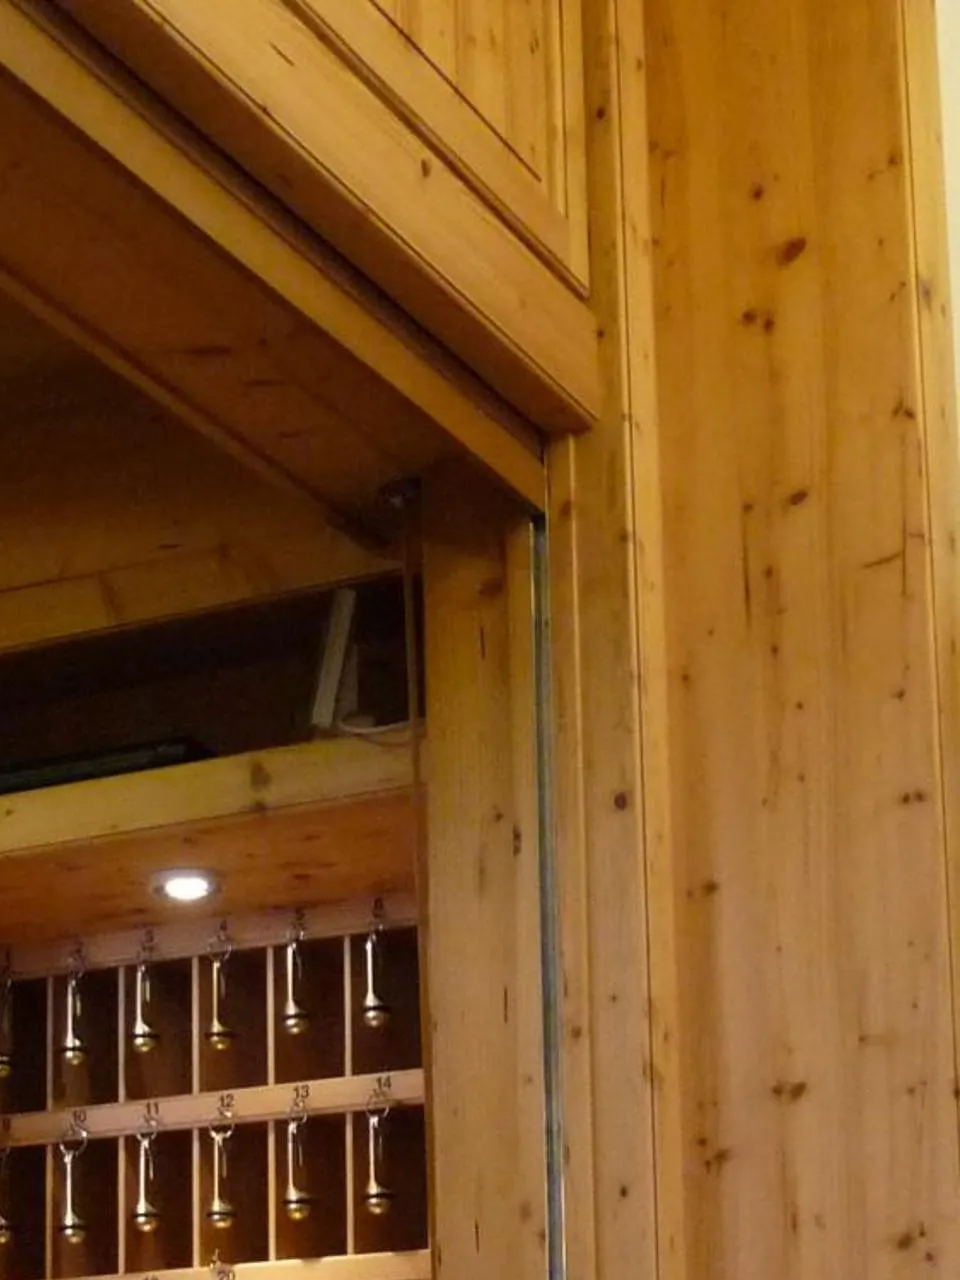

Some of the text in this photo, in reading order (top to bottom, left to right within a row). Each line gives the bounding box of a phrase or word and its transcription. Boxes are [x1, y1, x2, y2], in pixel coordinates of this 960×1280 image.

[376, 1074, 392, 1091] 14
[293, 1083, 310, 1100] 13
[144, 1100, 160, 1117] 11
[218, 1092, 235, 1109] 12
